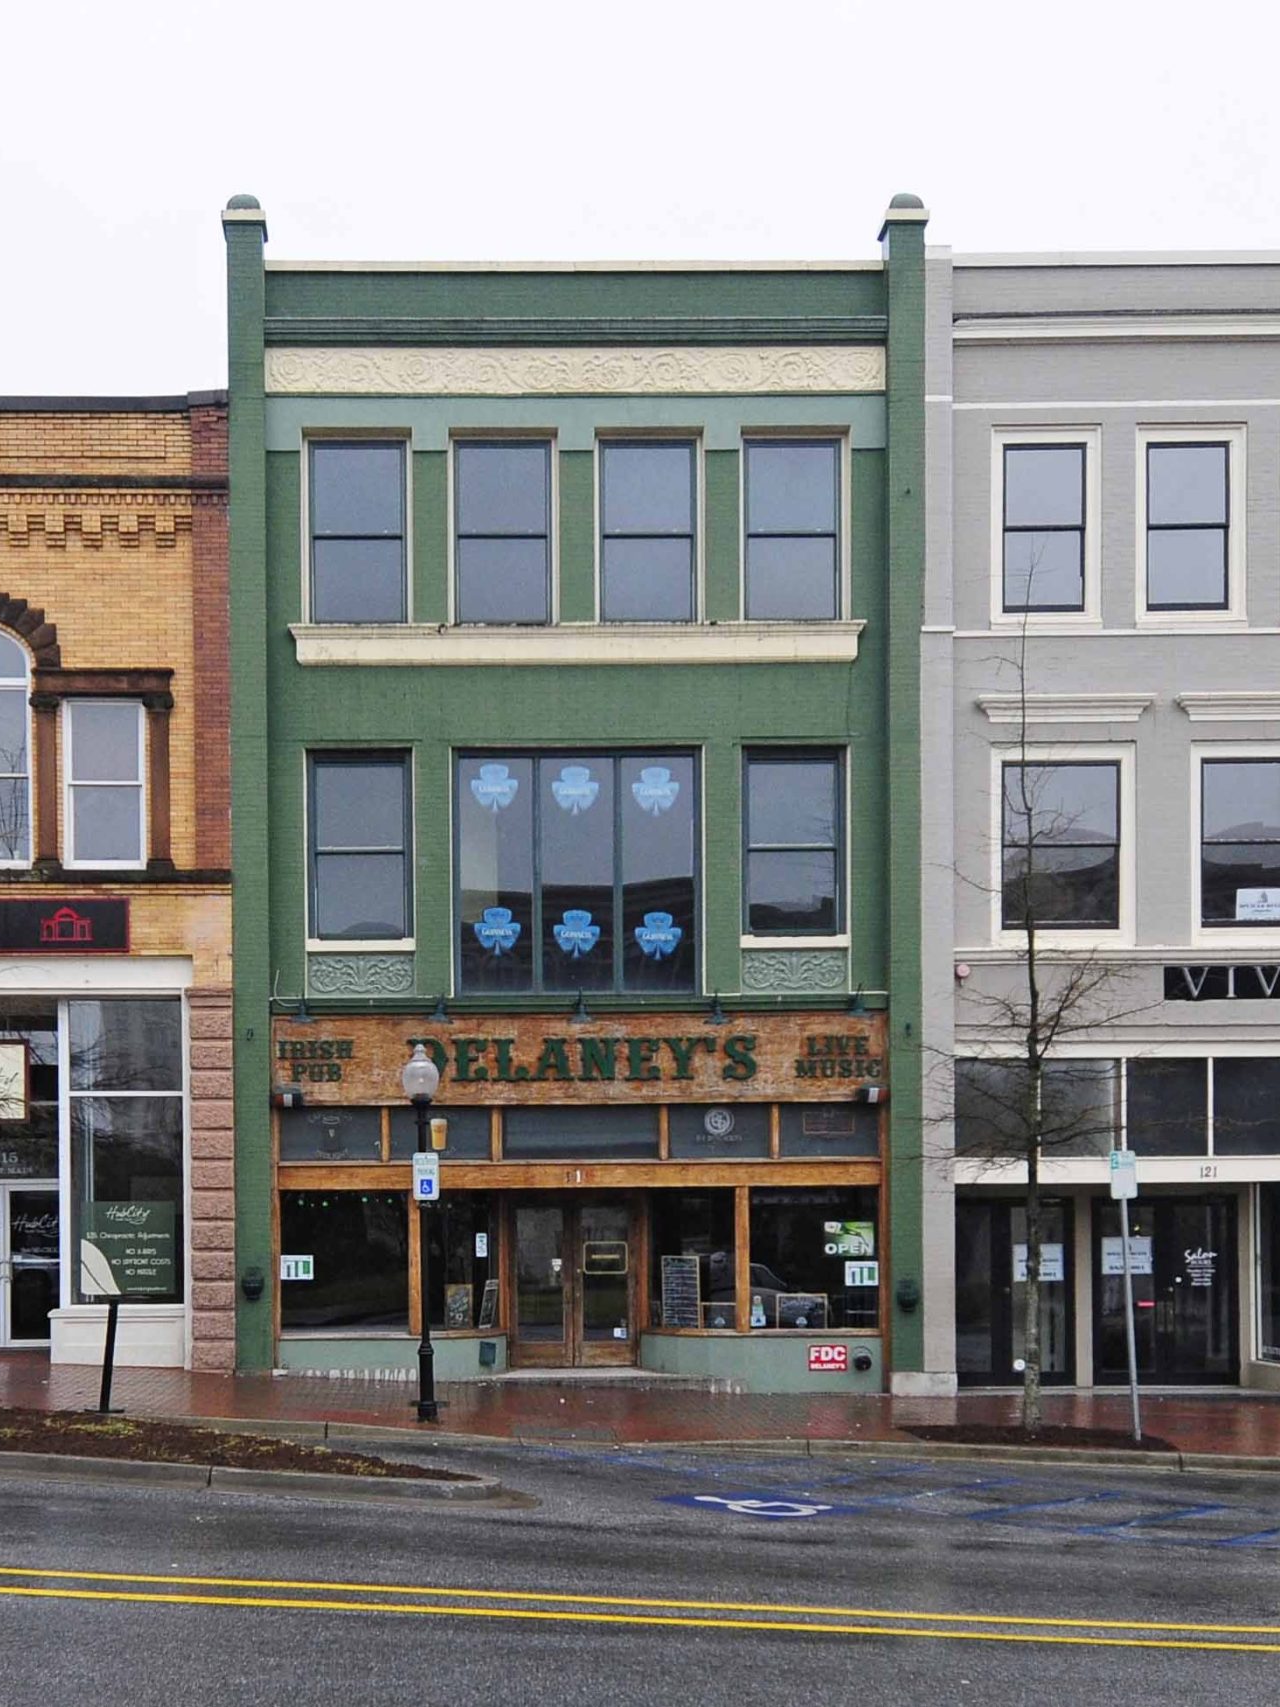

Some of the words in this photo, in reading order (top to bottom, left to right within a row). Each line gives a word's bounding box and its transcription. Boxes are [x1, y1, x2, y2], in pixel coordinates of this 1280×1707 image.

[277, 1040, 354, 1059] IRISH
[806, 1034, 871, 1056] LIVE
[407, 1034, 758, 1082] DELANEY'S
[292, 1062, 342, 1082] PUB
[794, 1057, 883, 1079] MUSIC
[1200, 1165, 1217, 1178] 121
[11, 1213, 58, 1231] HubCit
[824, 1243, 874, 1255] OPEN
[1184, 1248, 1218, 1263] Salon
[810, 1347, 847, 1361] FDC
